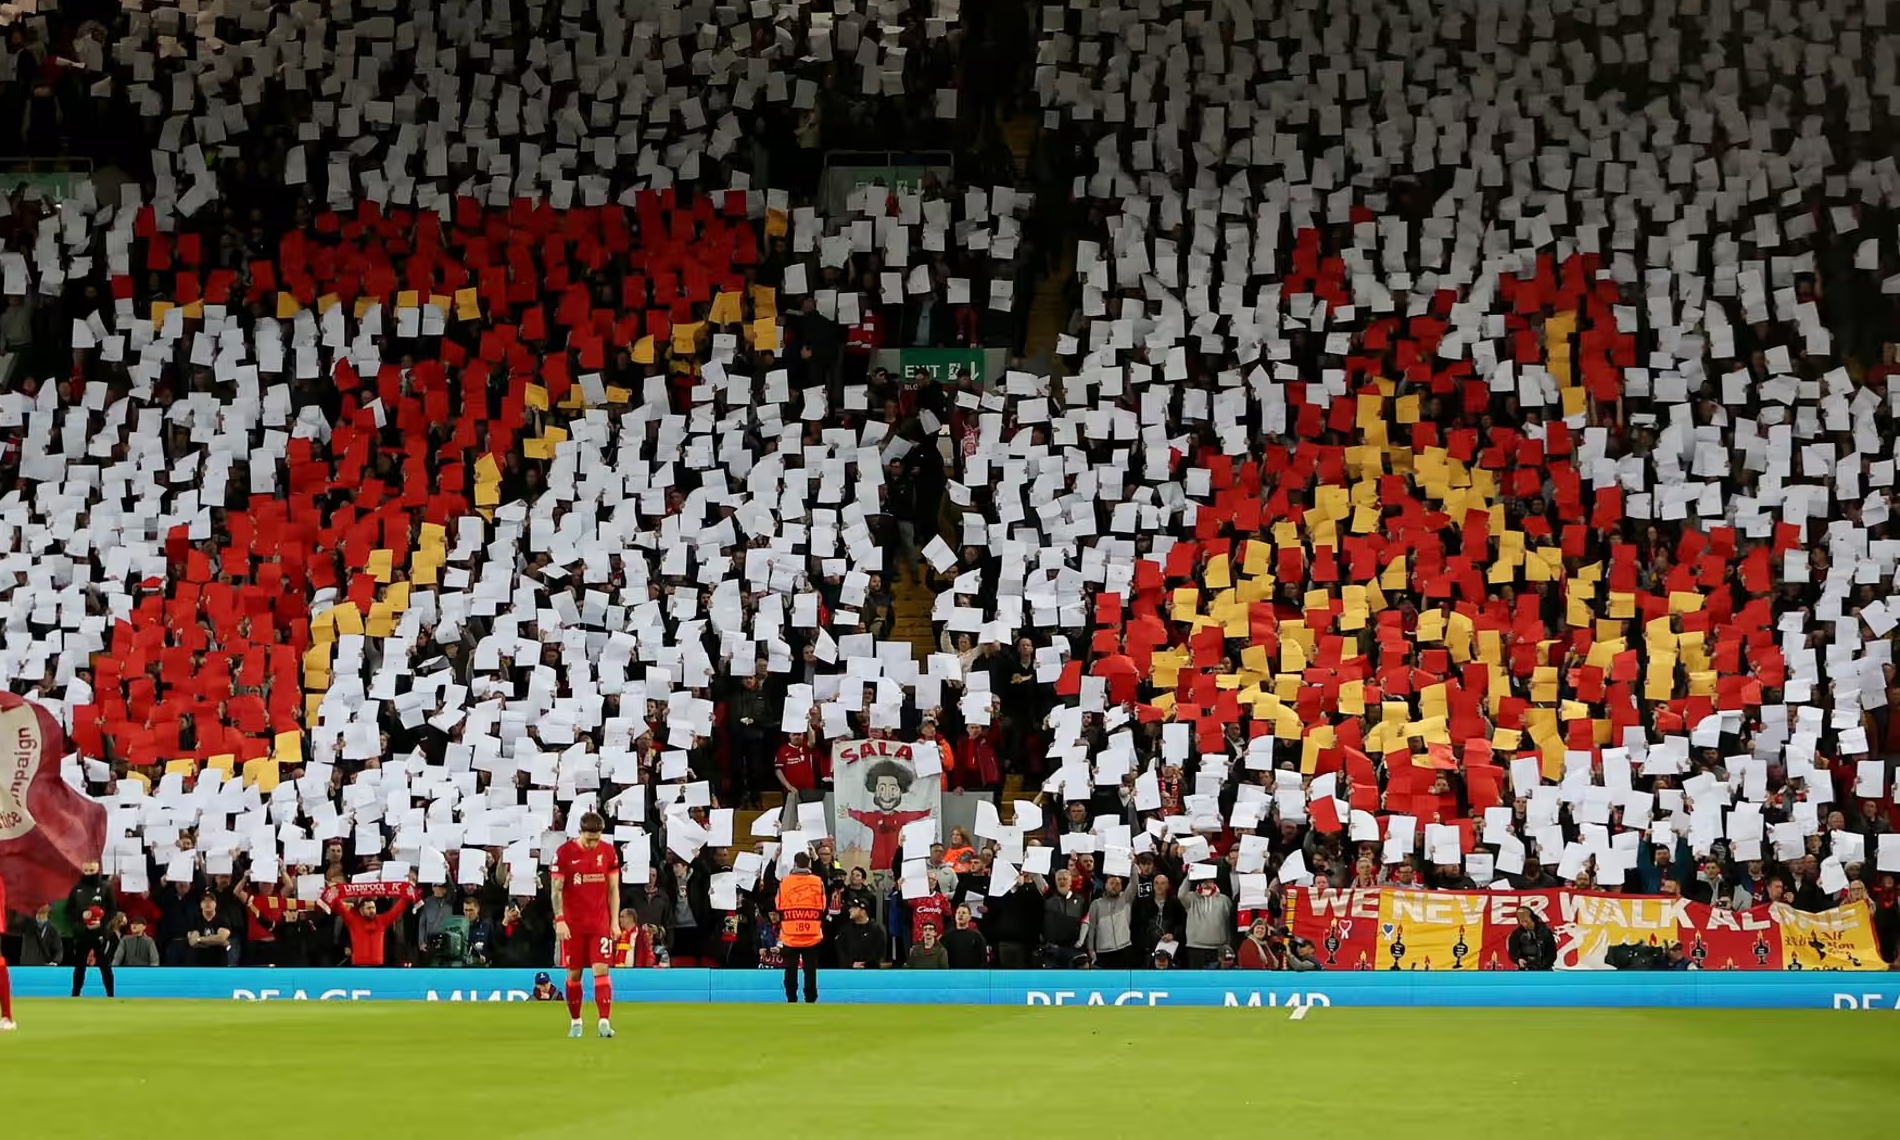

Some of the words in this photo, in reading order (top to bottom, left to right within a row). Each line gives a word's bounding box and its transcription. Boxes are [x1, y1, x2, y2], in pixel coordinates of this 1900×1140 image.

[343, 883, 386, 892] LIVERPOOL
[391, 882, 402, 891] FC
[783, 909, 820, 920] STEWARD
[1308, 887, 1380, 919] WE
[1391, 890, 1550, 925] NEVER
[1559, 892, 1696, 929] WALK
[600, 936, 613, 954] 21
